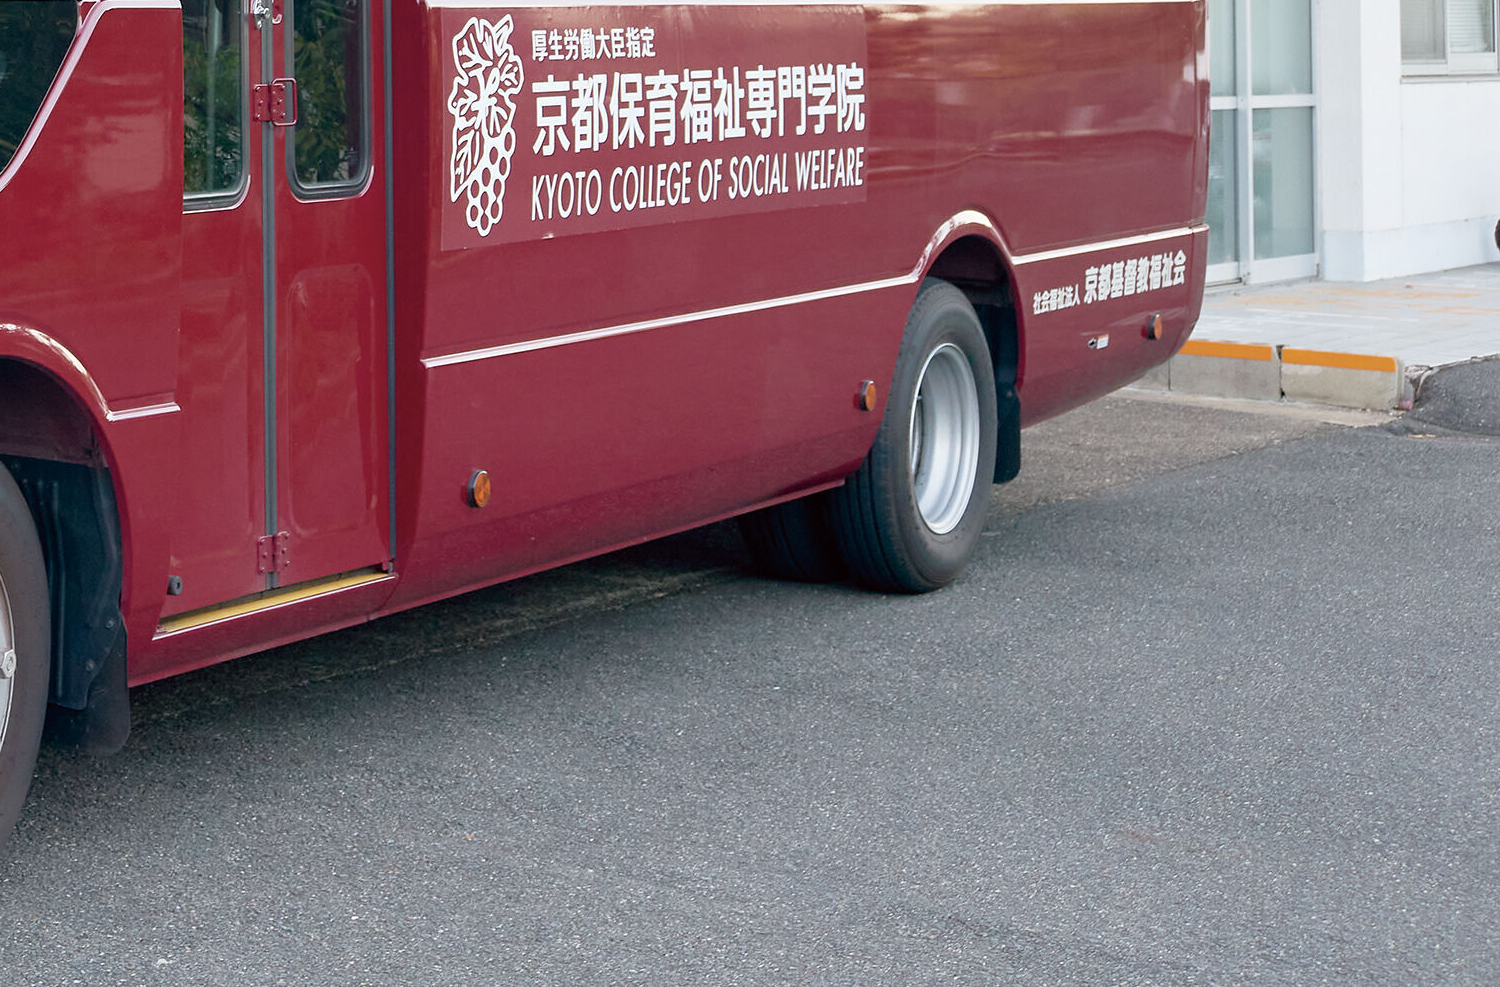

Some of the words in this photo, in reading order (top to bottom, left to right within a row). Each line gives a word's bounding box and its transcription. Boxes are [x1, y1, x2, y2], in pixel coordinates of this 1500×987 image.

[531, 26, 656, 62] 厚生労働大臣指定
[531, 62, 866, 156] 京都保育福祉専門学院
[531, 168, 602, 222] KYOTO
[609, 160, 692, 213] COLLEGE
[699, 157, 723, 203] OF
[728, 153, 789, 200] SOCIAL
[795, 146, 864, 192] WELFARE
[1033, 283, 1081, 315] 社会福祉法人
[1083, 249, 1187, 304] 京都基督教福祉会
